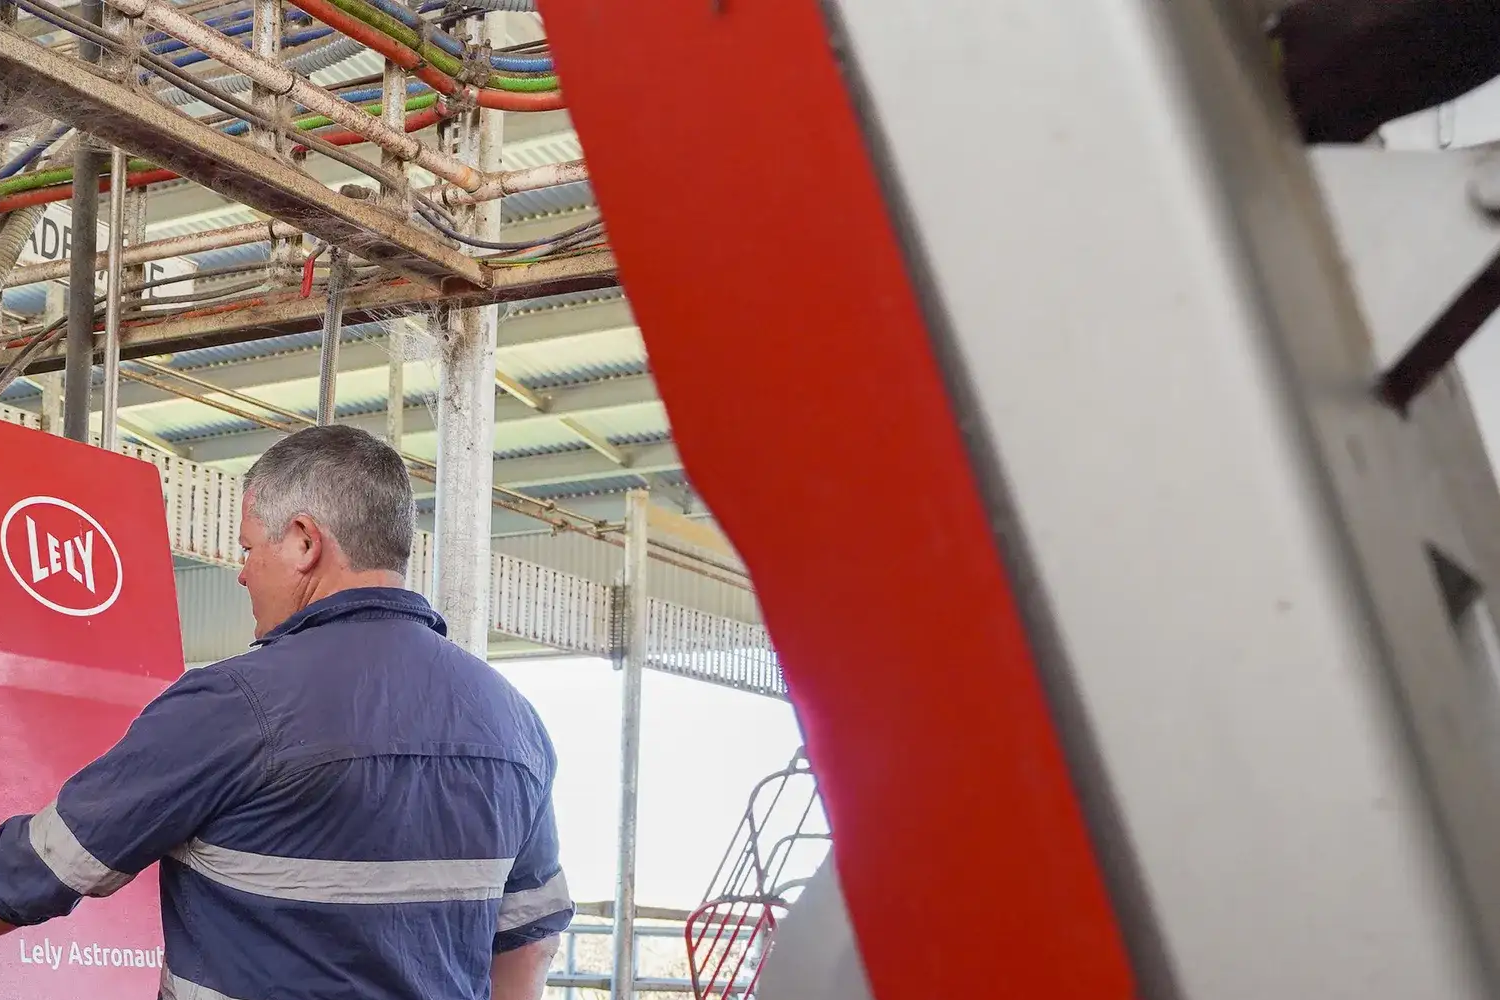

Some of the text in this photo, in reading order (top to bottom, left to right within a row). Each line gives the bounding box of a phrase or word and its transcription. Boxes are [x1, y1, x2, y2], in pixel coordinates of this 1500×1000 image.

[25, 514, 96, 594] LELY
[20, 938, 165, 970] Lely Astronaut
